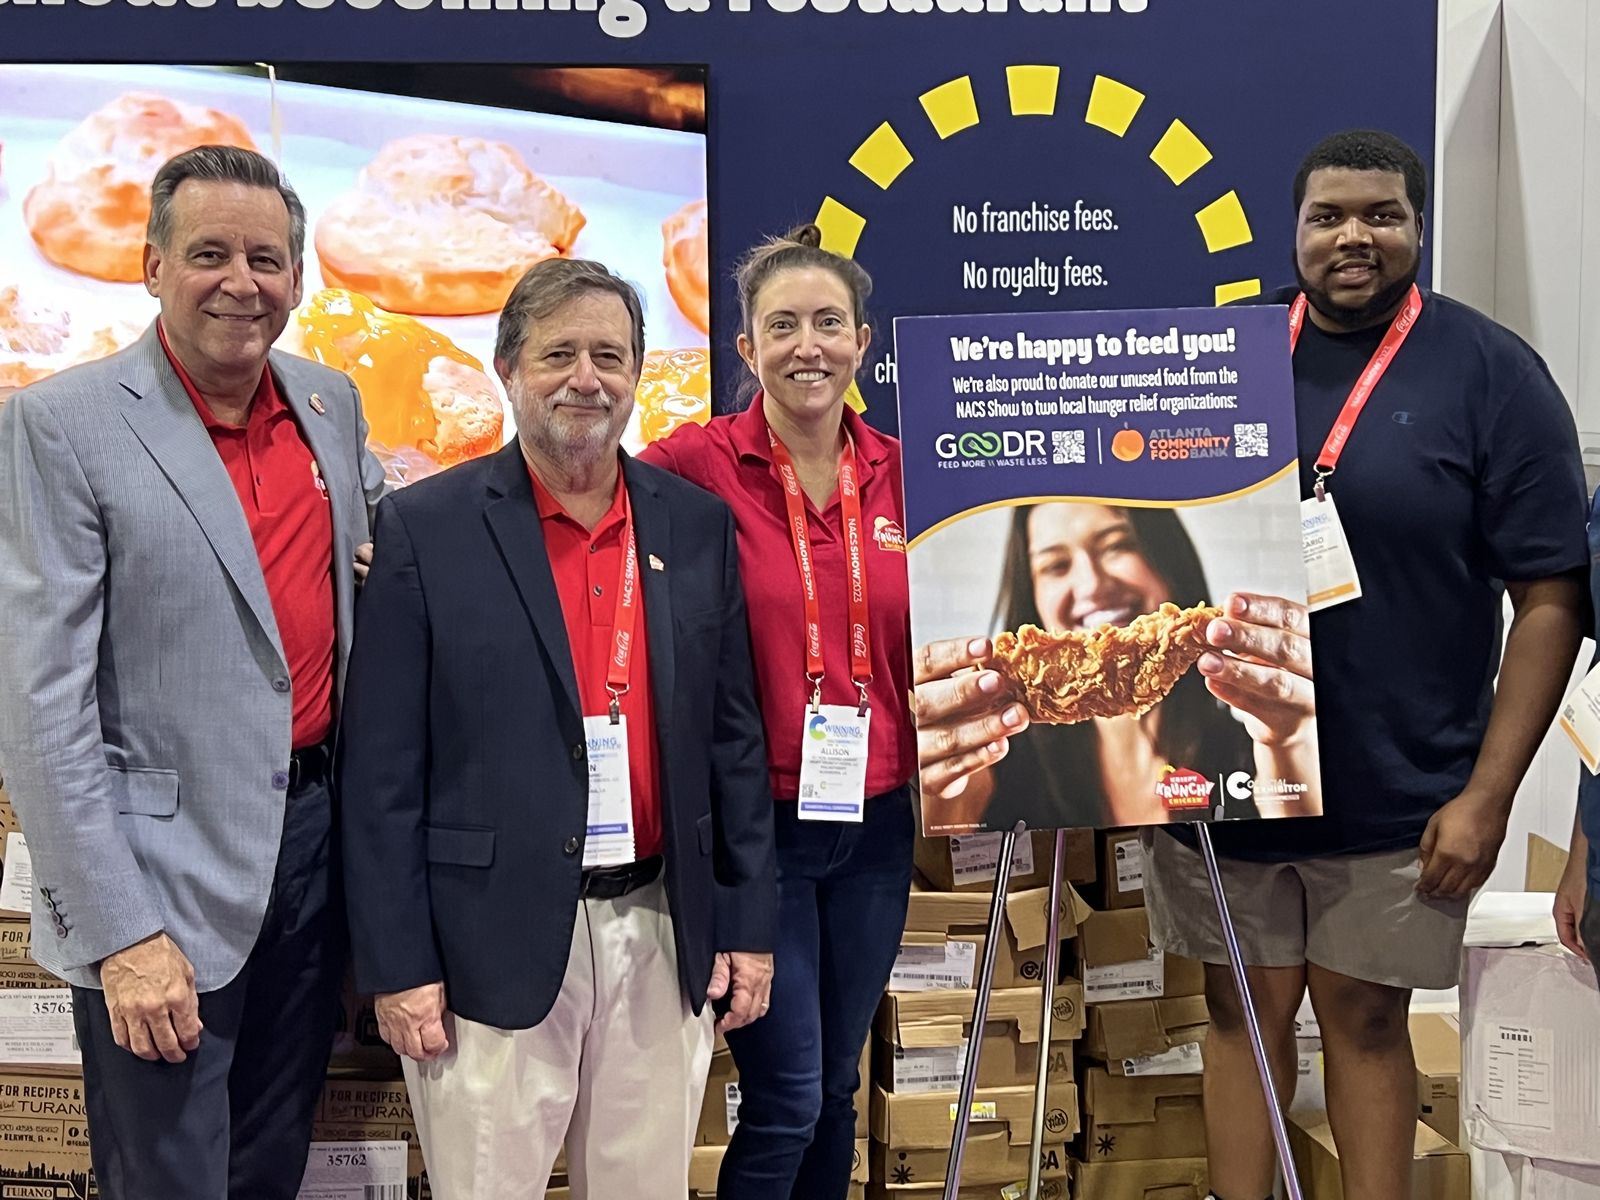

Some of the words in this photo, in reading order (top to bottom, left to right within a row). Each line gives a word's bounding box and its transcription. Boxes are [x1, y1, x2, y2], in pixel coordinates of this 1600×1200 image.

[953, 205, 977, 233] No
[982, 202, 1069, 232] franchise
[1074, 200, 1119, 231] fees.
[963, 261, 987, 289] No
[992, 257, 1059, 296] royalty
[1063, 256, 1108, 286] fees.
[951, 336, 1014, 362] We're
[1017, 332, 1093, 365] happy
[1096, 334, 1122, 356] to
[1125, 328, 1180, 355] feed
[1183, 328, 1236, 360] you!
[953, 376, 984, 394] We're
[986, 373, 1009, 393] also
[1011, 372, 1044, 396] proud
[1045, 374, 1058, 390] to
[1059, 370, 1098, 390] donate
[1100, 373, 1119, 389] our
[1120, 369, 1162, 388] unused
[1163, 368, 1189, 386] food
[1189, 367, 1217, 386] from
[1218, 366, 1238, 385] the
[956, 401, 986, 419] NACS
[987, 398, 1020, 417] Show
[1021, 400, 1034, 416] to
[1034, 400, 1058, 415] two
[1060, 396, 1086, 414] local
[1088, 396, 1127, 418] hunger
[1129, 392, 1159, 413] relief
[1160, 393, 1238, 416] organizations:
[1149, 427, 1213, 439] ATLANTA
[935, 430, 1047, 459] GOODR
[1149, 436, 1231, 450] COMMUNITY
[938, 460, 960, 469] FEED
[961, 459, 986, 468] MORE
[996, 458, 1025, 467] WASTE
[1026, 457, 1048, 466] LESS
[821, 747, 850, 757] ALLISON
[1155, 781, 1215, 799] KRUNCHY
[2, 931, 23, 943] FOR
[33, 1002, 73, 1015] 35762
[0, 1085, 19, 1097] FOR
[23, 1086, 69, 1100] RECIPES
[73, 1089, 80, 1100] &
[331, 1090, 352, 1101] FOR
[355, 1090, 401, 1103] RECIPES
[351, 1105, 413, 1119] TURAN
[327, 1154, 367, 1167] 35762
[6, 1187, 53, 1198] TURANO
